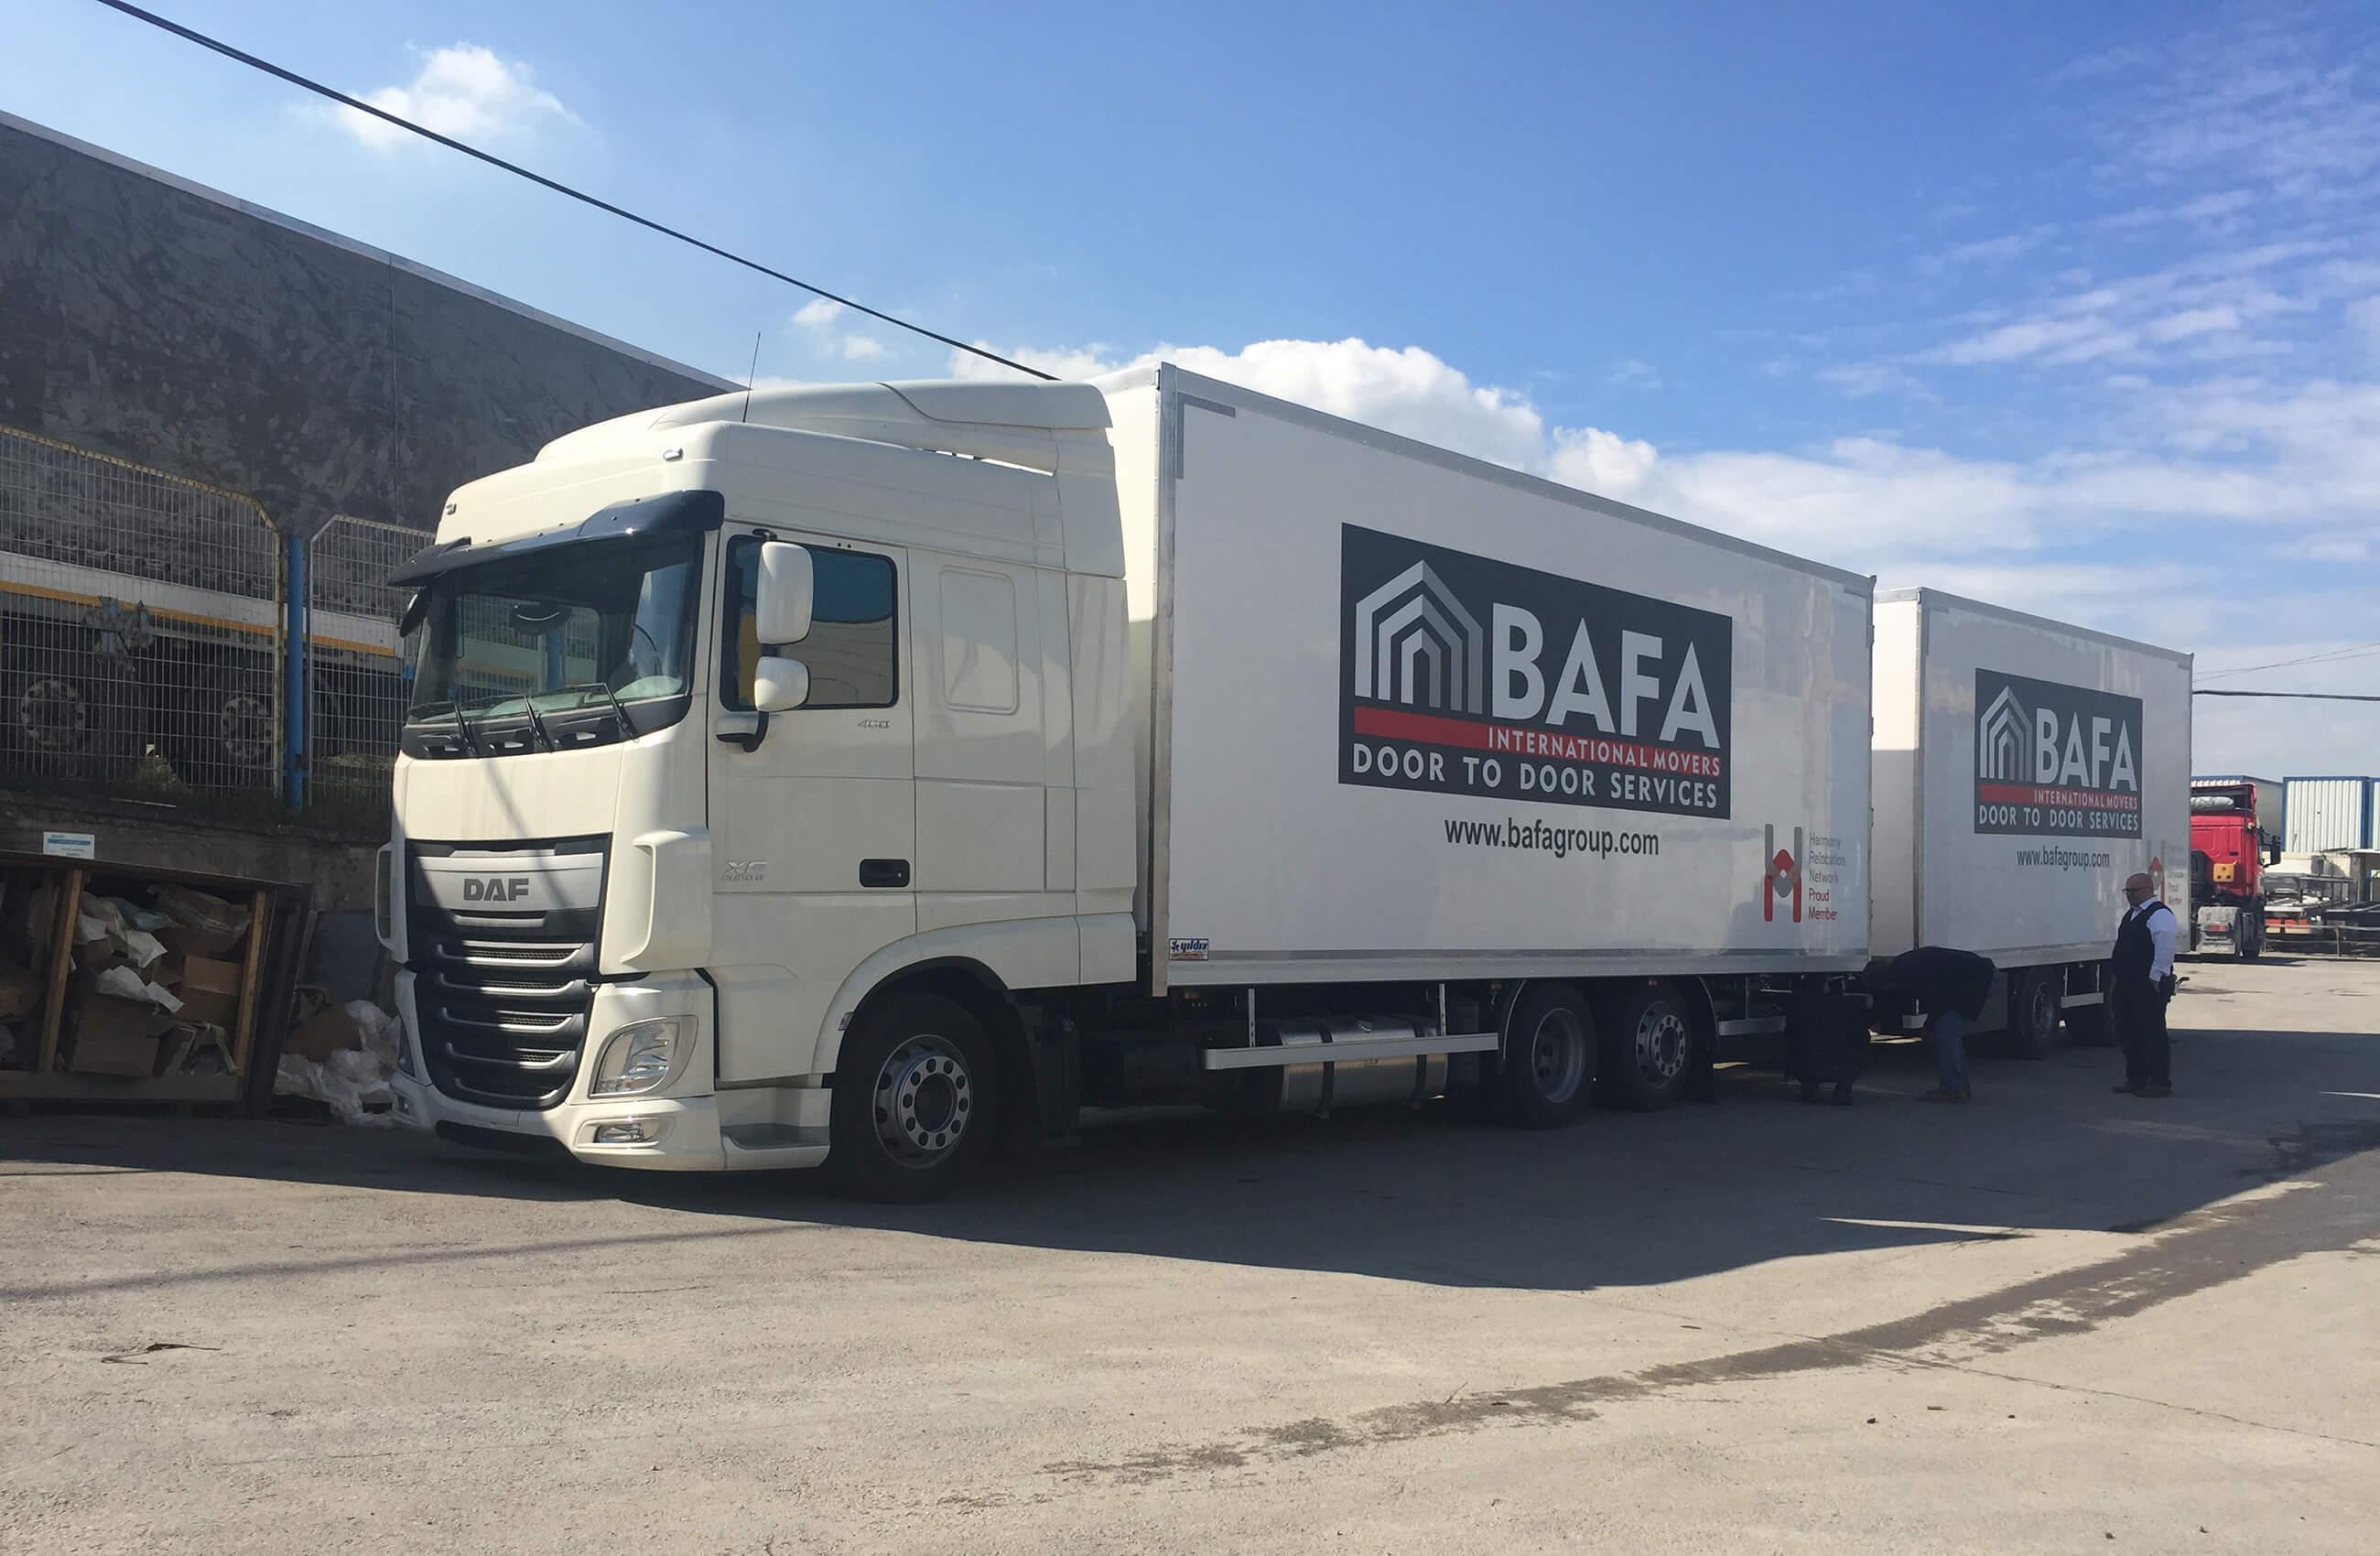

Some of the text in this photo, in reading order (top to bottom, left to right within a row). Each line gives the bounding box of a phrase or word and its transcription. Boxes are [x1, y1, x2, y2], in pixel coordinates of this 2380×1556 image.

[1492, 602, 1721, 749] BAFA
[1488, 727, 1721, 777] INTERNATIONAL MOVERS
[2035, 708, 2137, 792] BAFA
[1353, 743, 1717, 809] DOOR TO DOOR SERVICES
[2034, 790, 2137, 810] INTERNATIONAL MOVERS
[1979, 805, 2138, 831] DOOR TO DOOR SERVICES
[1444, 817, 1660, 859] www.bafagroup.com
[1809, 832, 1841, 849] Harmony
[1809, 850, 1846, 866] Relocation
[2017, 846, 2110, 871] www.bafagroup.com
[1809, 870, 1838, 884] Network
[463, 878, 529, 902] DAF
[1808, 887, 1830, 902] Proud
[1808, 906, 1838, 920] Member
